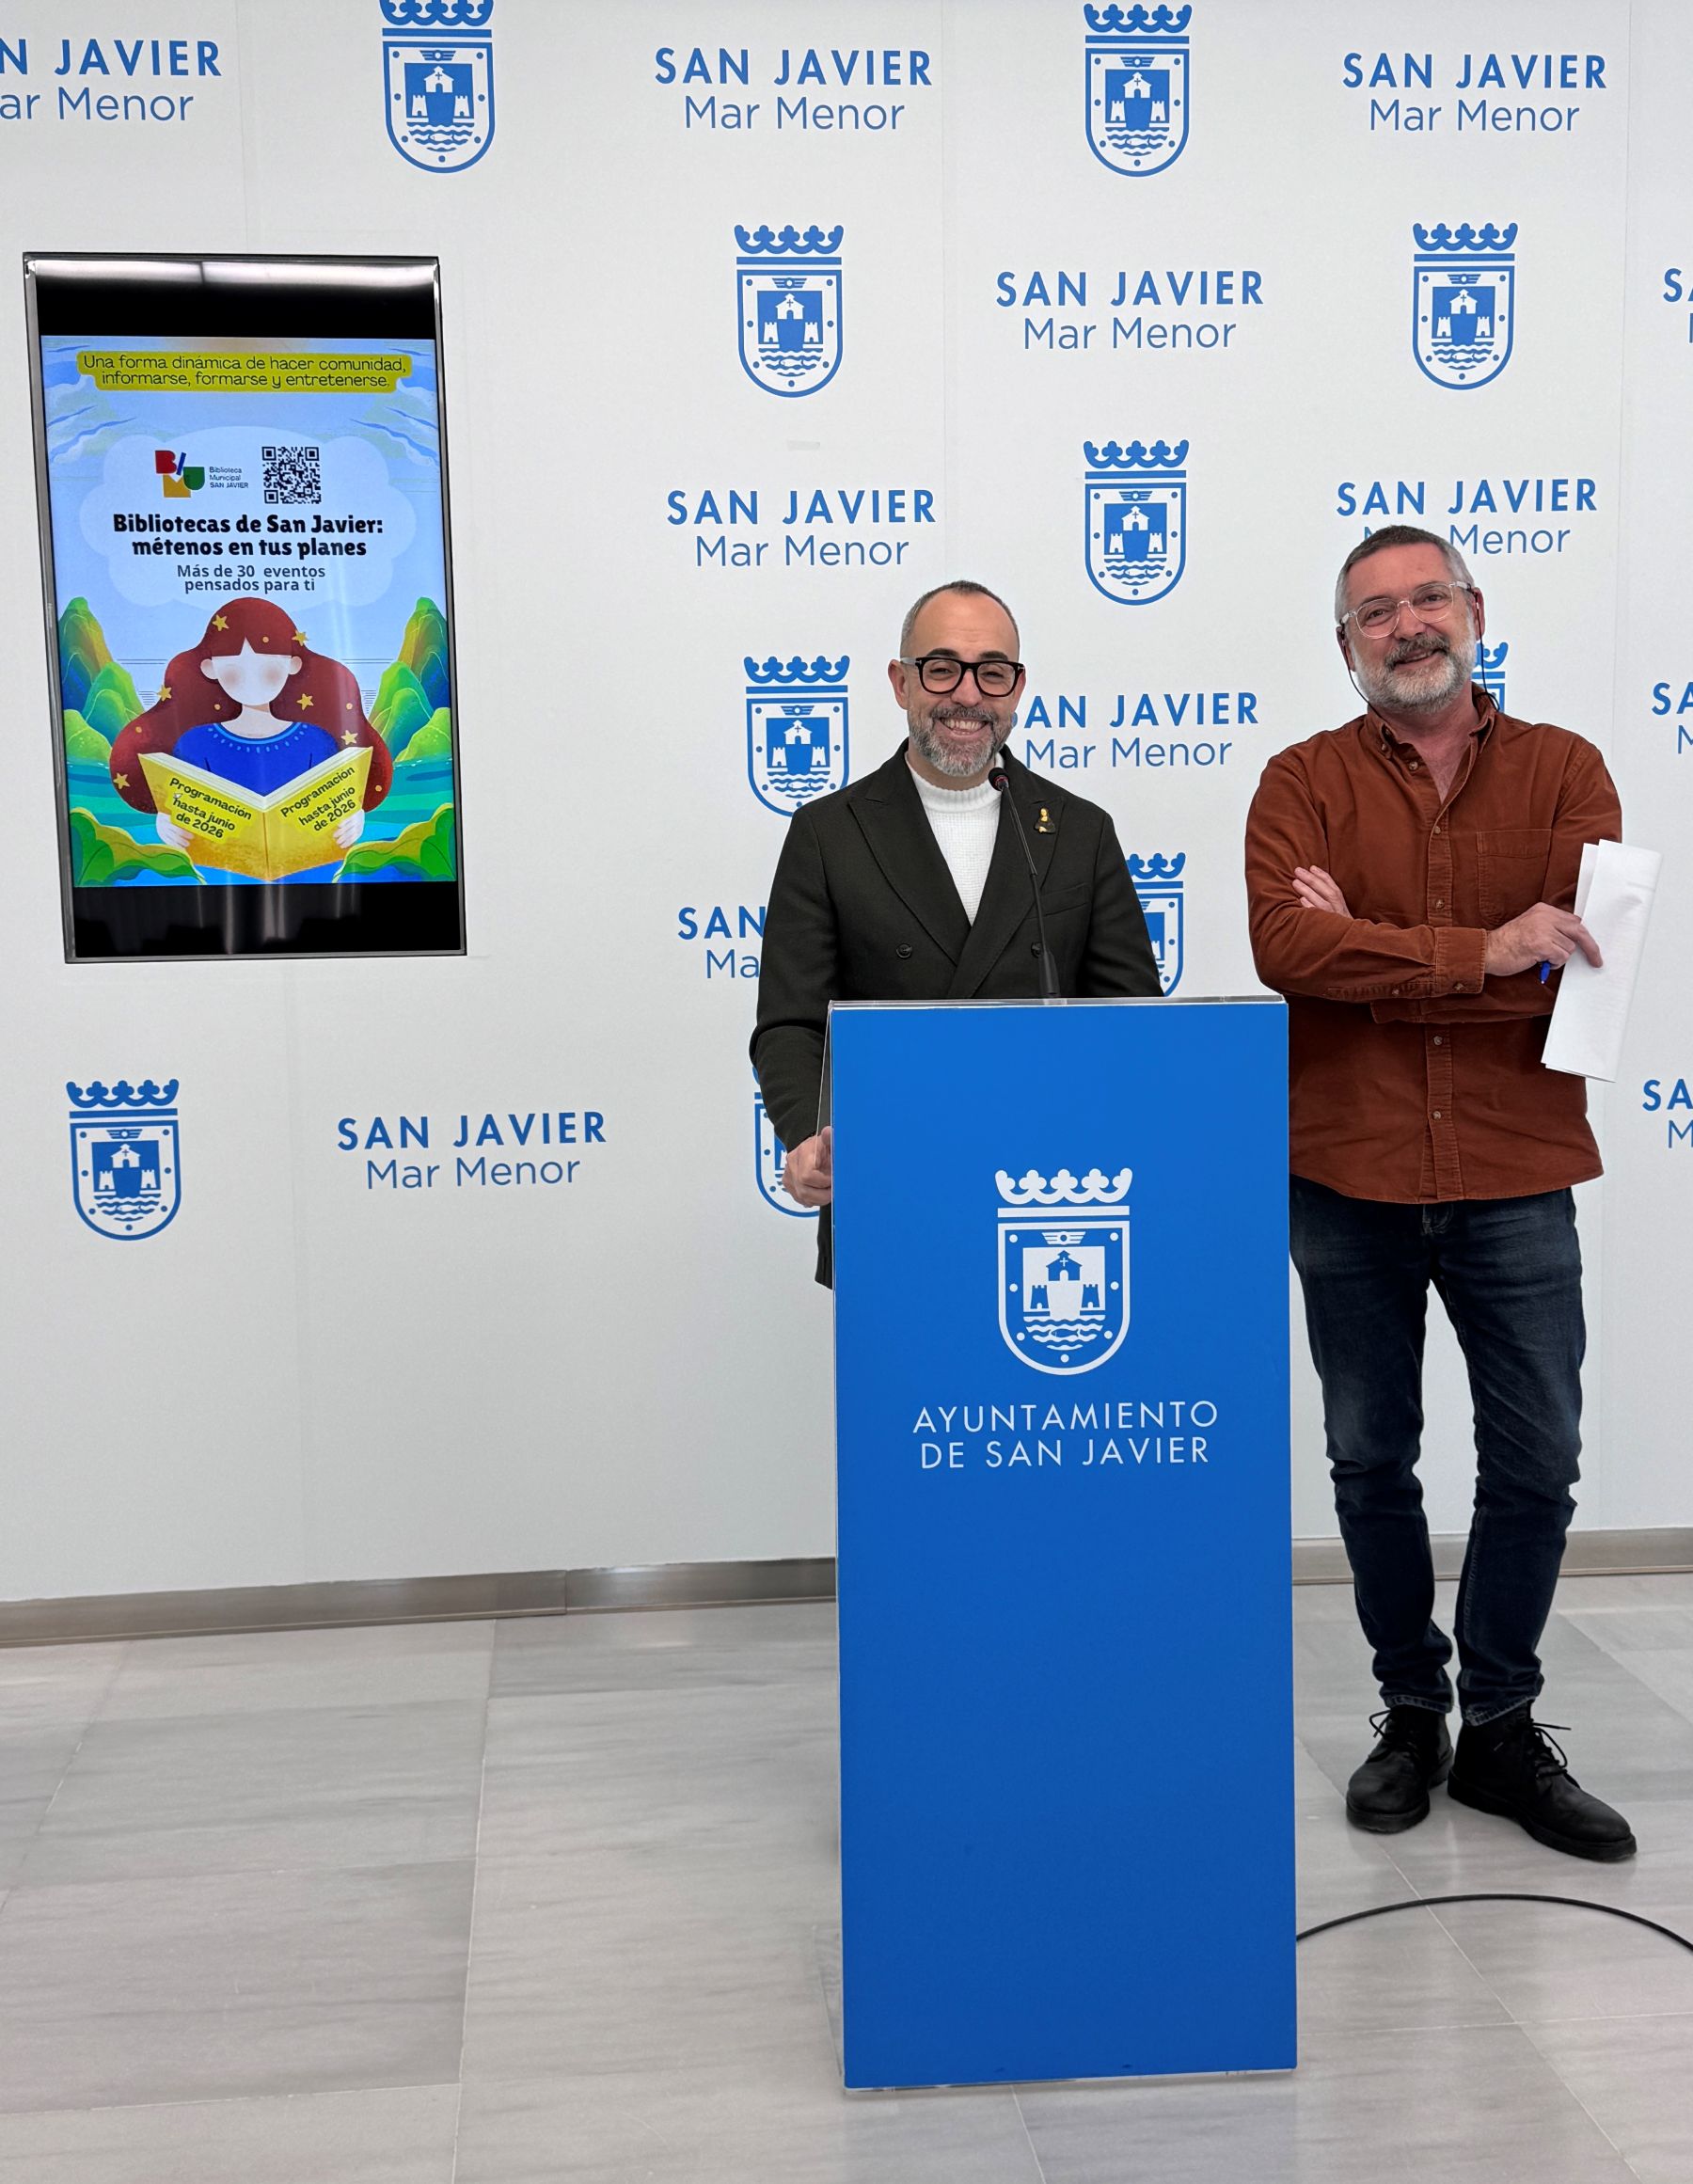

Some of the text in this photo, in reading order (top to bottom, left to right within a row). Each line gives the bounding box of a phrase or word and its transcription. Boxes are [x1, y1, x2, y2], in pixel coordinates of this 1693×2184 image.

[54, 39, 222, 76] JAVIER
[655, 47, 932, 87] SAN JAVIER
[1342, 52, 1606, 89] SAN JAVIER
[0, 87, 194, 120] ar Menor
[685, 96, 906, 130] Mar Menor
[1369, 99, 1580, 132] Mar Menor
[996, 270, 1264, 308] SAN JAVIER
[1023, 317, 1236, 350] Mar Menor
[84, 355, 406, 373] Una forma dinámica de hacer comunidad,
[103, 371, 191, 387] informarse,
[196, 372, 268, 386] formarse
[272, 376, 281, 388] y
[209, 466, 243, 474] Biblioteca
[667, 489, 935, 526] SAN JAVIER
[1336, 478, 1598, 517] SAN JAVIER
[113, 513, 383, 533] Bibliotecas de San Javier:
[1449, 524, 1571, 555] Menor
[132, 536, 367, 561] métenos en tus planes
[696, 534, 910, 567] Mar Menor
[177, 563, 325, 578] Más de 30 eventos
[184, 578, 315, 594] pensados para ti
[1010, 691, 1259, 730] AN JAVIER
[1025, 736, 1233, 769] Mar Menor
[169, 777, 252, 820] Programación
[280, 767, 356, 818] Programación
[298, 786, 356, 826] hasta junio
[172, 797, 236, 831] hasta junio
[176, 813, 225, 839] de 2026
[313, 799, 356, 831] de 2026
[677, 905, 767, 941] SAN
[706, 948, 760, 979] Ma
[1642, 1078, 1693, 1112] SA
[337, 1110, 607, 1152] SAN JAVIER
[366, 1157, 580, 1191] Mar Menor
[912, 1400, 1219, 1433] AYUNTAMIENTO
[921, 1436, 1210, 1469] DE SAN JAVIER
